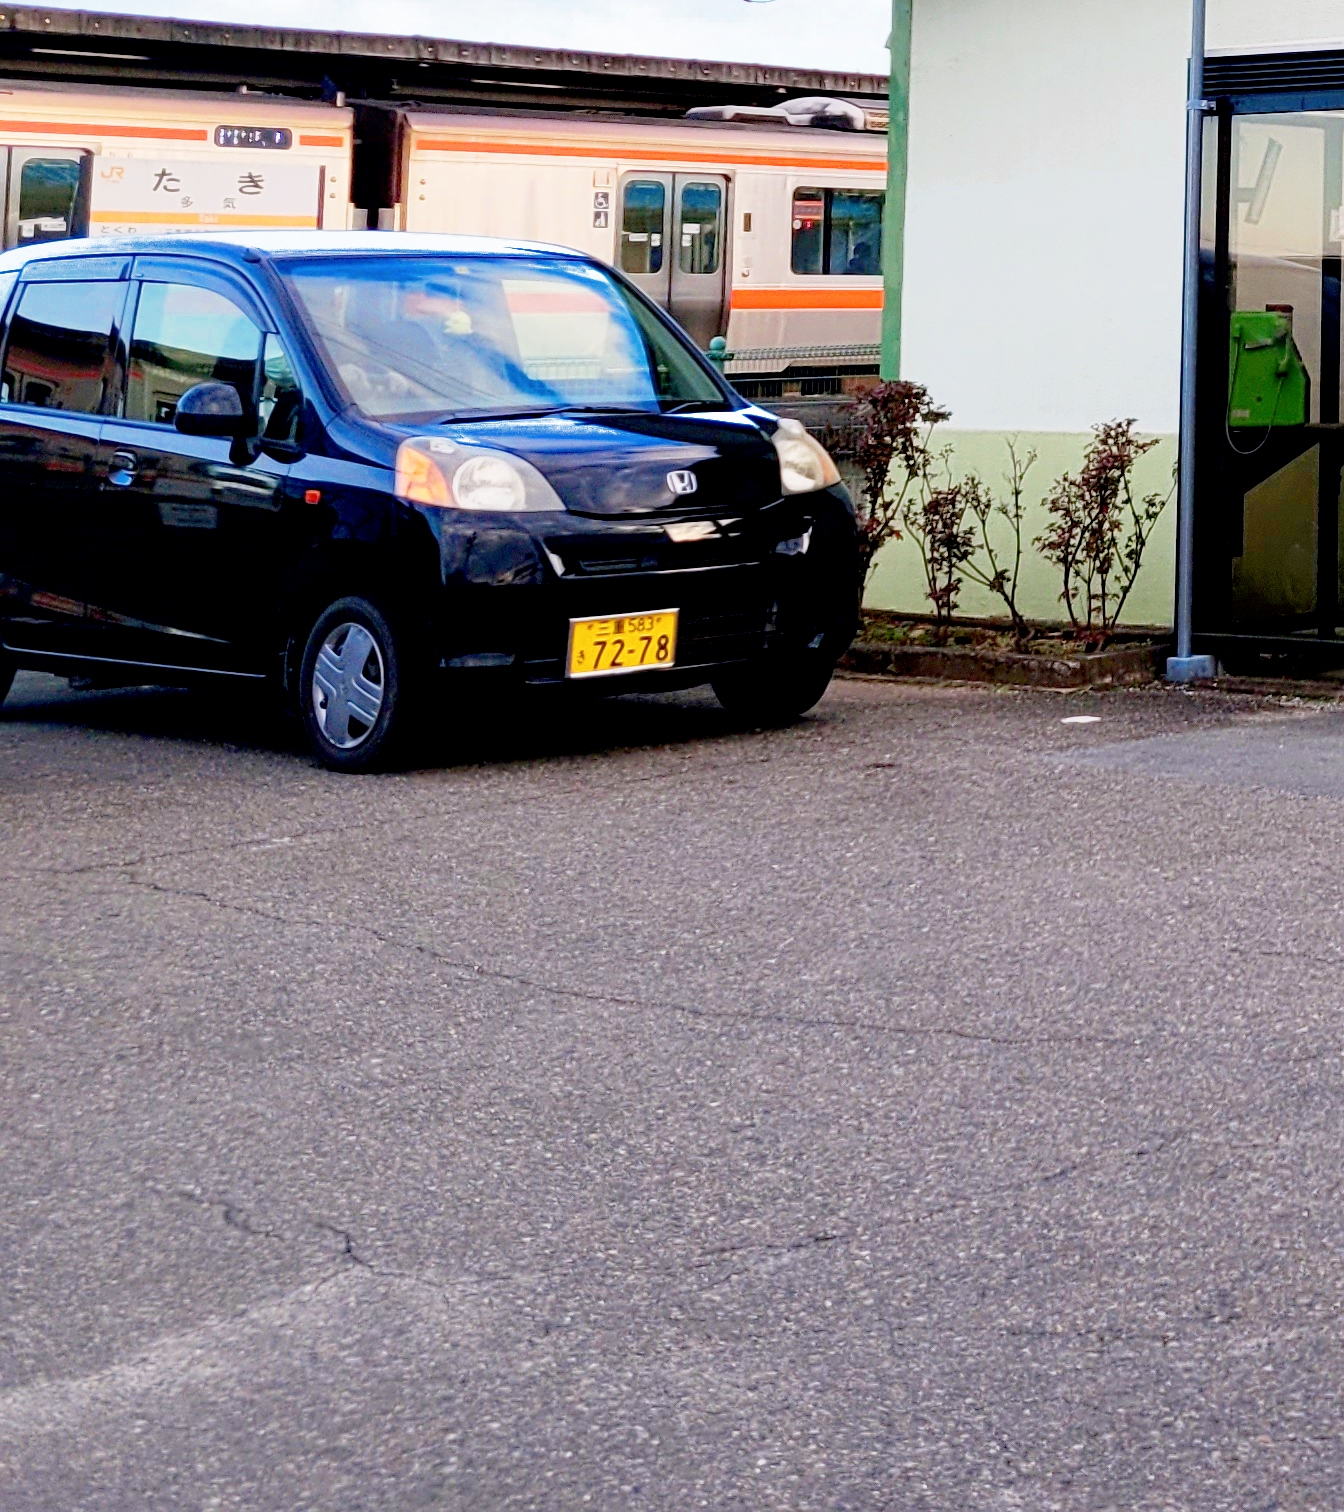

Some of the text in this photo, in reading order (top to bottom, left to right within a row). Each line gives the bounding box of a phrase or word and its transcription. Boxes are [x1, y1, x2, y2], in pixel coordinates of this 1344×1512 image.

[101, 166, 124, 180] JR
[152, 167, 265, 196] たき
[180, 195, 236, 209] 多気
[100, 224, 138, 235] とくわ
[627, 615, 655, 633] 583
[593, 634, 670, 670] 72-78
